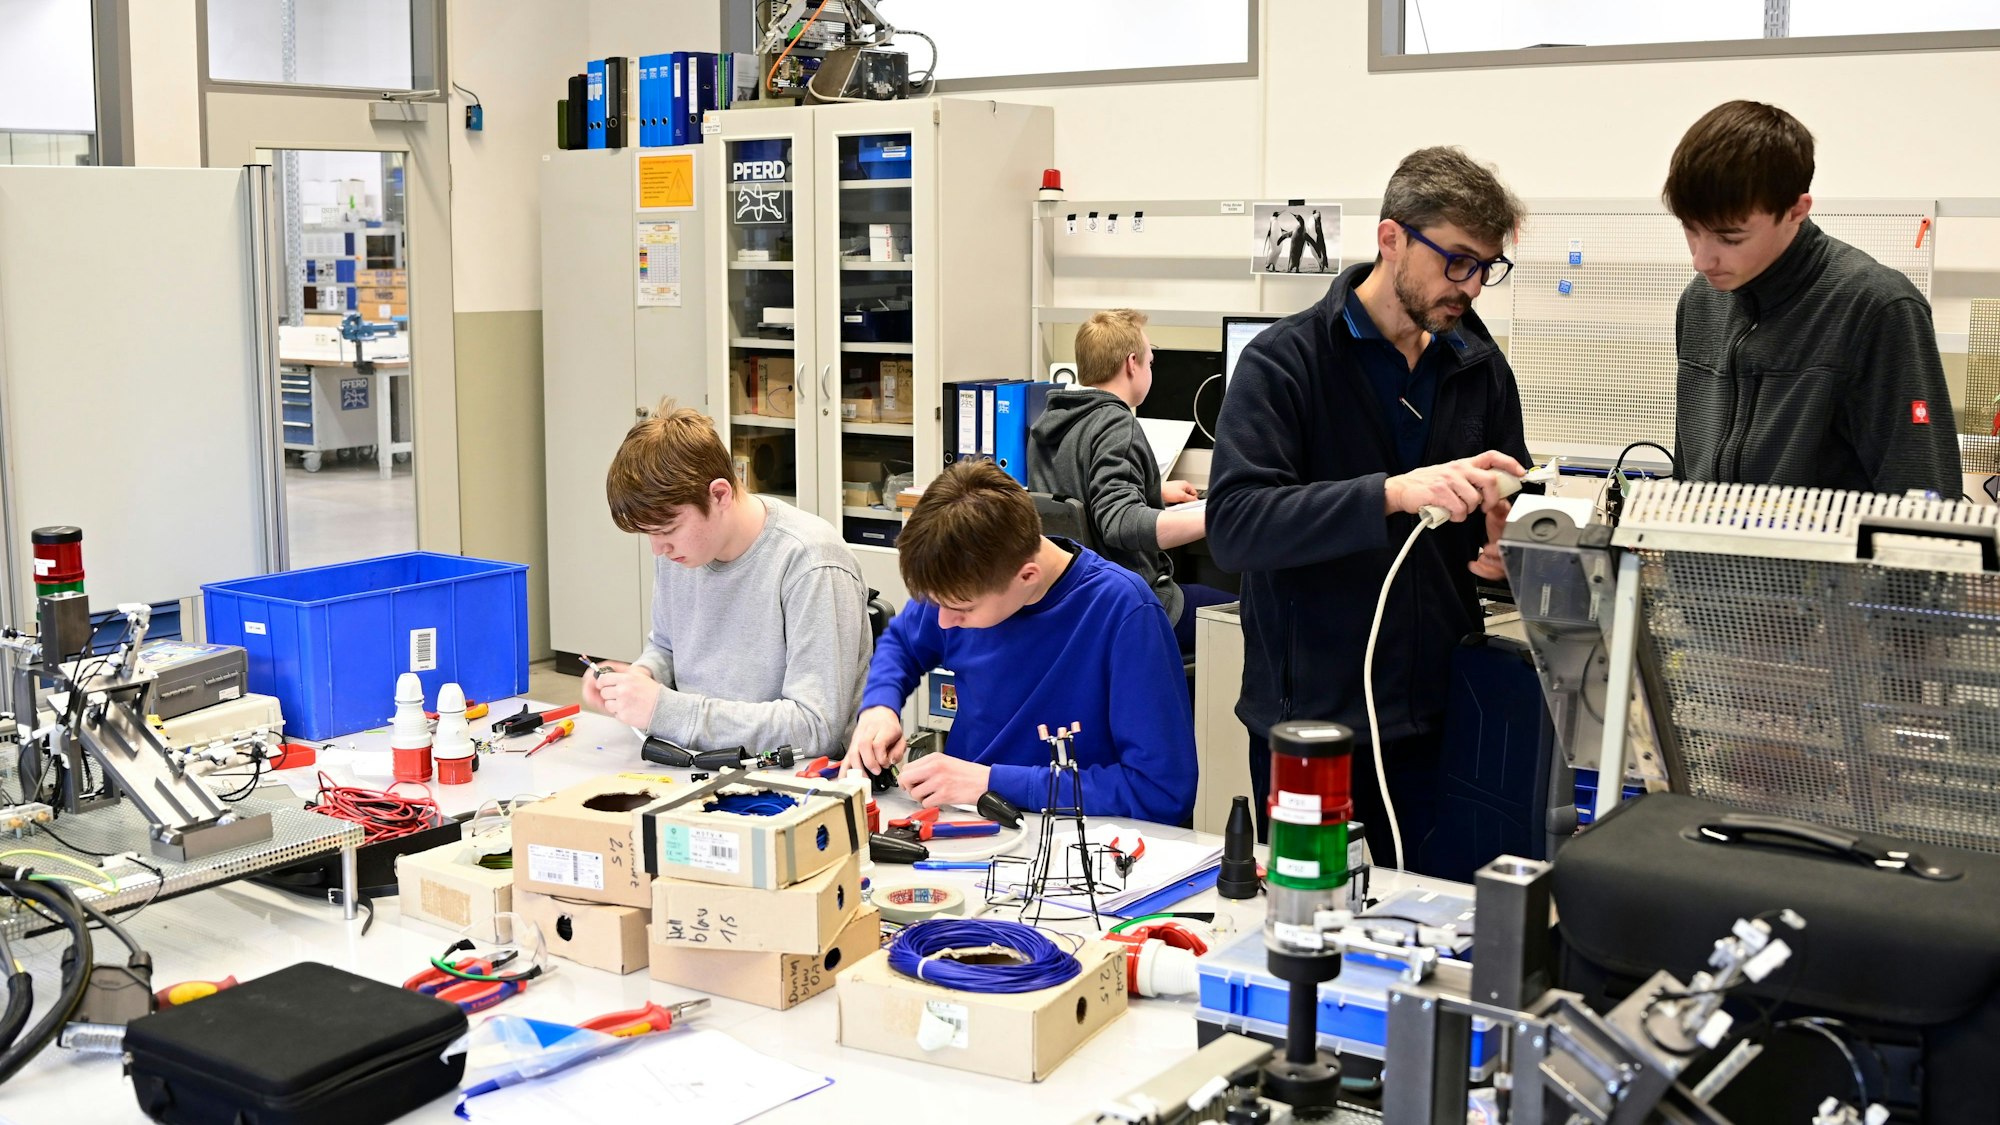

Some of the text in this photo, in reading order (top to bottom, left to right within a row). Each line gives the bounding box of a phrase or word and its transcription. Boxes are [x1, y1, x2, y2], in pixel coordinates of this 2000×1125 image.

[733, 160, 785, 180] PFERD
[341, 379, 367, 389] PFERD
[609, 837, 624, 867] 2,5
[666, 919, 686, 940] Hell
[689, 908, 710, 943] blau
[1099, 969, 1111, 1005] 2,5
